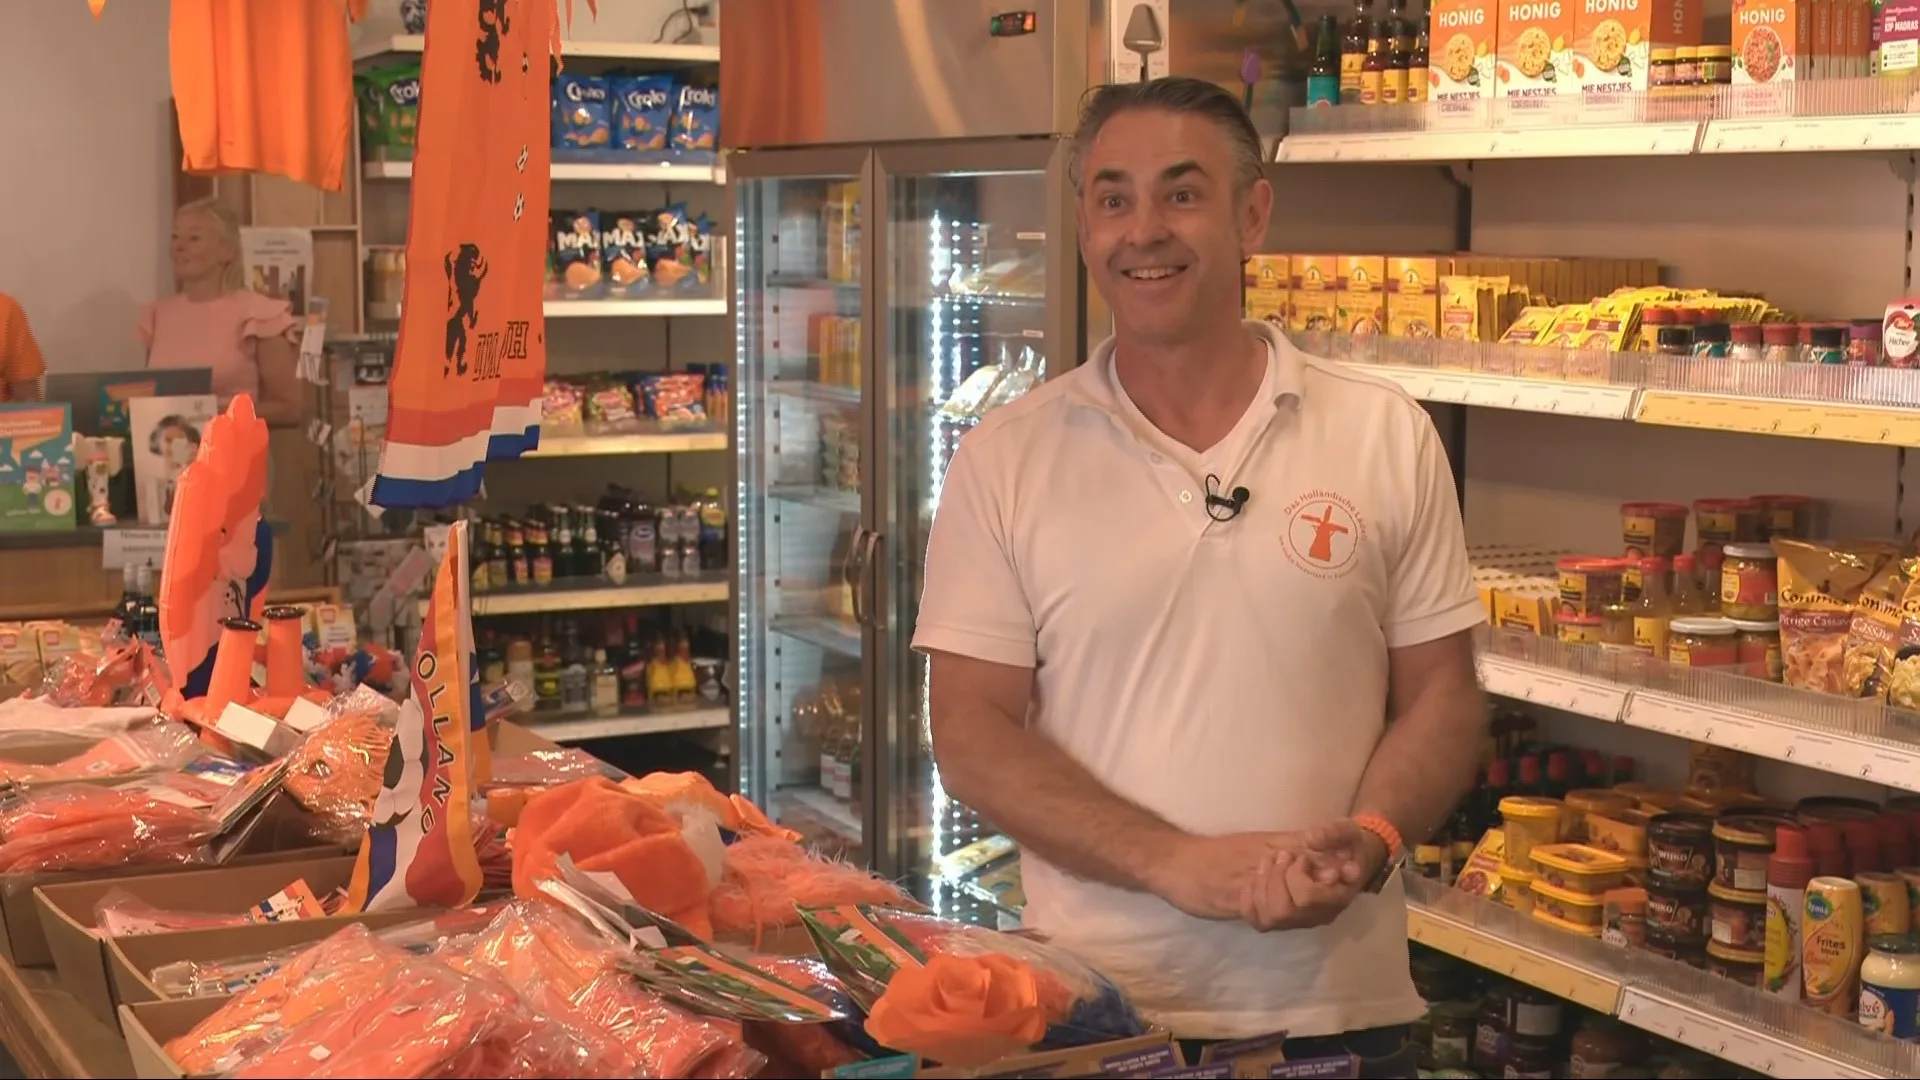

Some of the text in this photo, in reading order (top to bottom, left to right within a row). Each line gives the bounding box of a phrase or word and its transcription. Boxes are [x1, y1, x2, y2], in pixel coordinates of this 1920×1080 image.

[1509, 2, 1562, 21] HONIG
[1586, 0, 1639, 14] HONIG
[1439, 9, 1485, 28] HONIG
[1739, 8, 1786, 25] HONIG
[1284, 500, 1301, 516] Das
[1816, 935, 1846, 950] Frites
